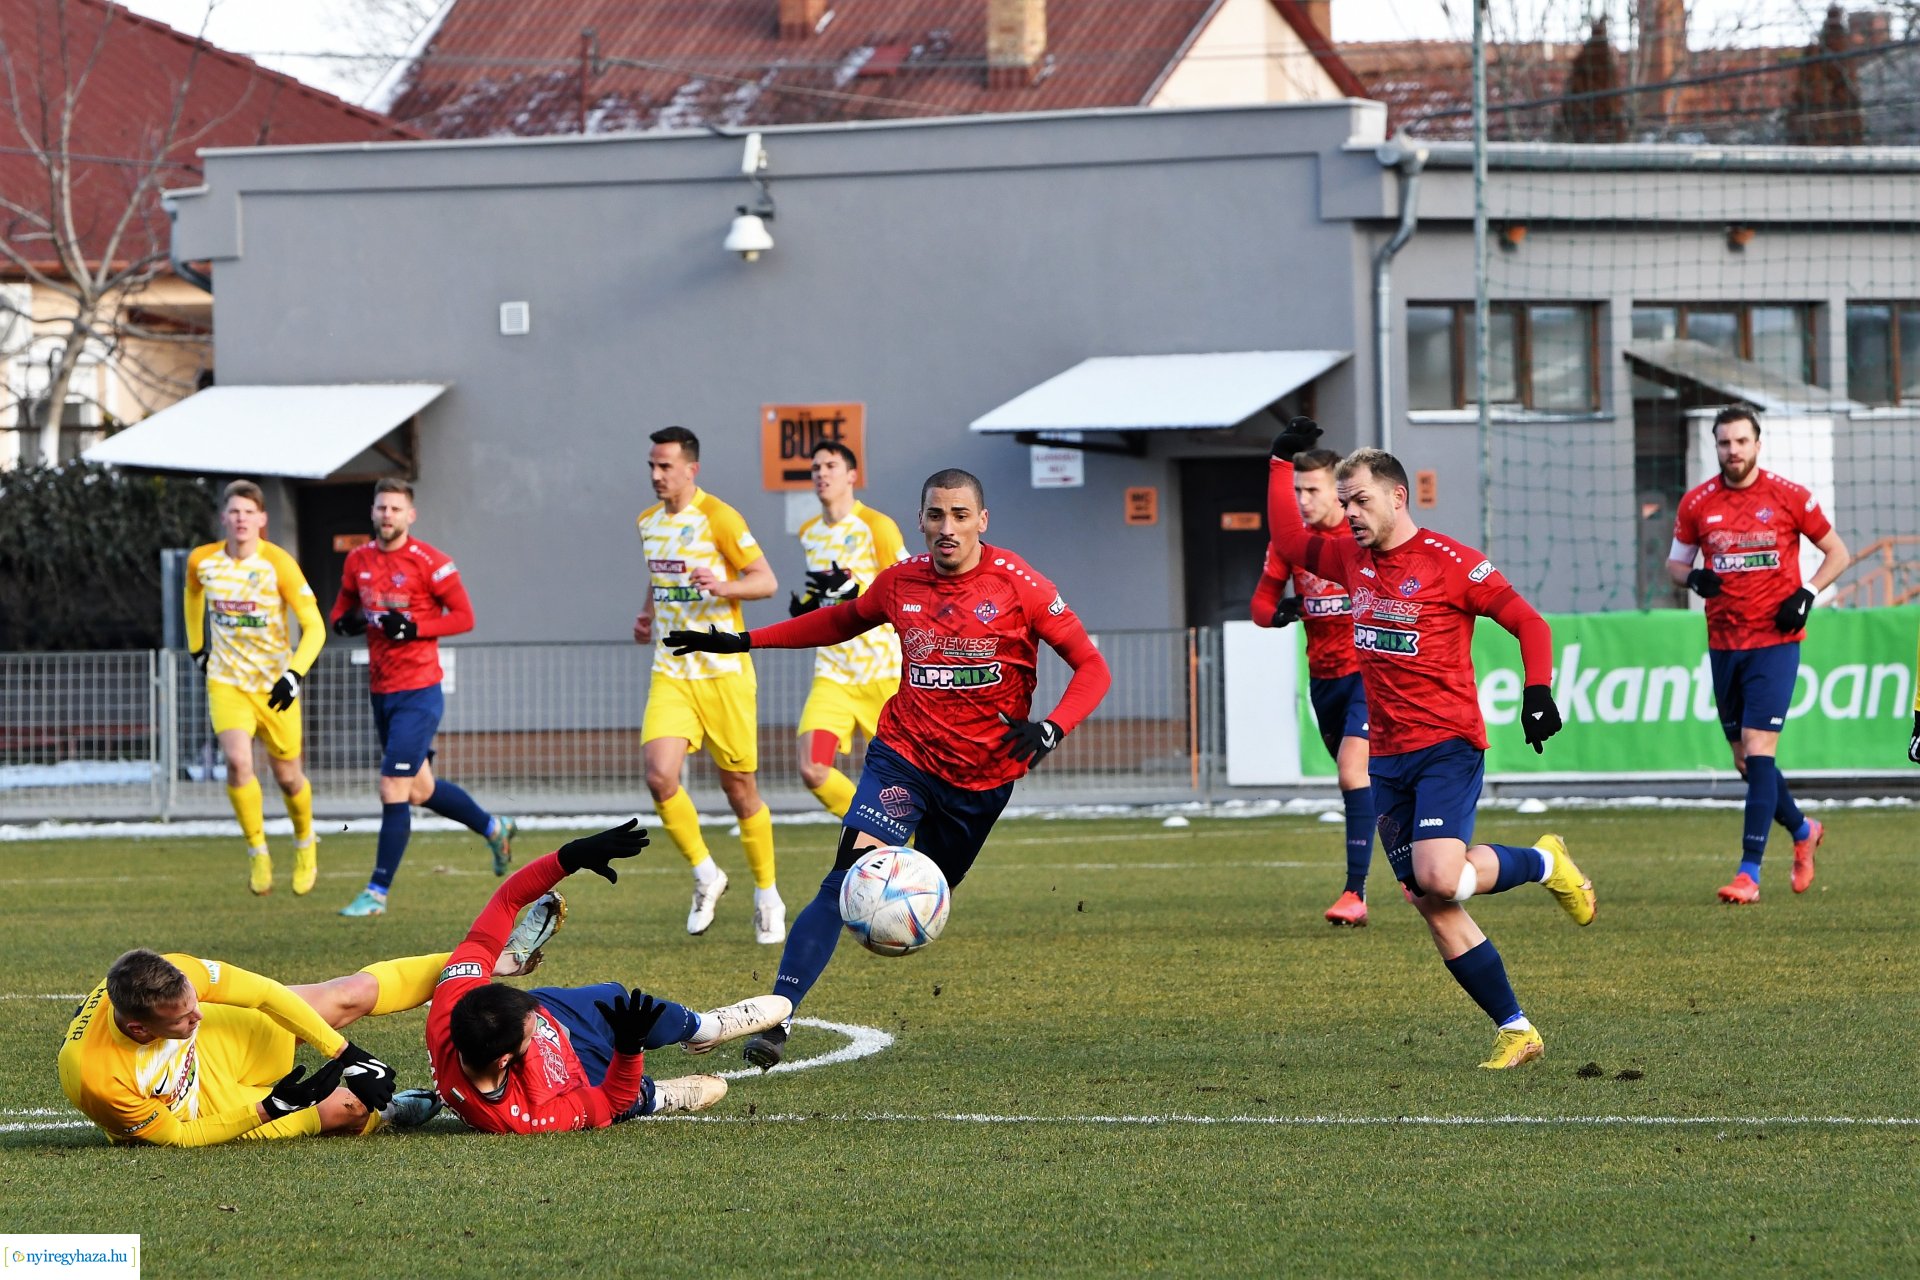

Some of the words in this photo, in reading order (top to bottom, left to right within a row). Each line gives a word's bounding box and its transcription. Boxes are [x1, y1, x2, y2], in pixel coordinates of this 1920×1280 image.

[654, 587, 701, 601] PPMIX
[1354, 627, 1415, 651] PPMIX
[860, 804, 908, 834] PRESTIGE
[1419, 818, 1444, 828] JAKO
[437, 963, 480, 983] TiPPM
